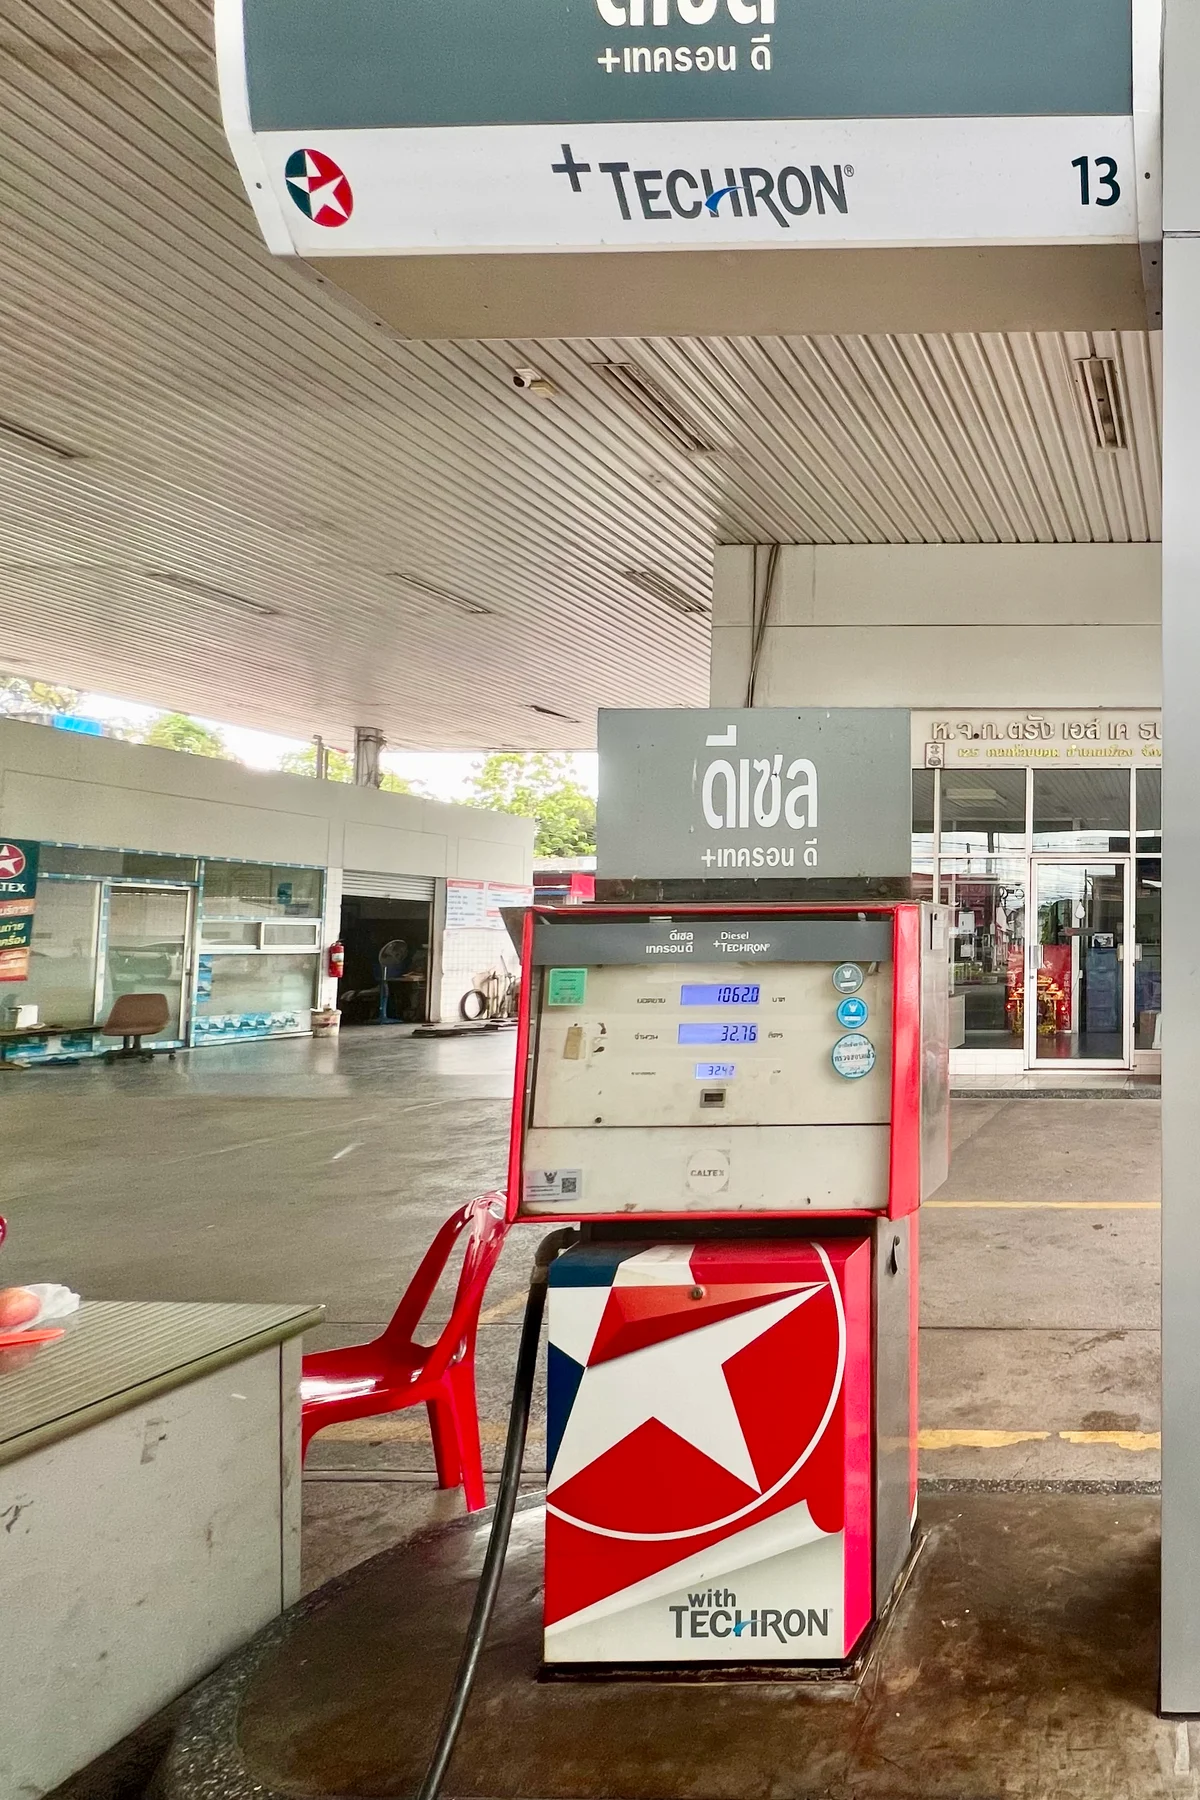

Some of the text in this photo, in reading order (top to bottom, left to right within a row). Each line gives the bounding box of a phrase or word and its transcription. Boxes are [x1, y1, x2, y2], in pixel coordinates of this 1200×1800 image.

[597, 34, 772, 74] +เทครอน ดี
[1070, 155, 1121, 207] 13
[702, 724, 819, 830] ดีเซล
[700, 838, 819, 869] +เทครอน ดี
[669, 929, 694, 941] ดีเซล
[720, 931, 749, 940] Diesel
[717, 986, 760, 1003] 1062.0
[721, 1025, 758, 1041] 32.76
[690, 1168, 725, 1178] CALTEX
[688, 1588, 737, 1608] with
